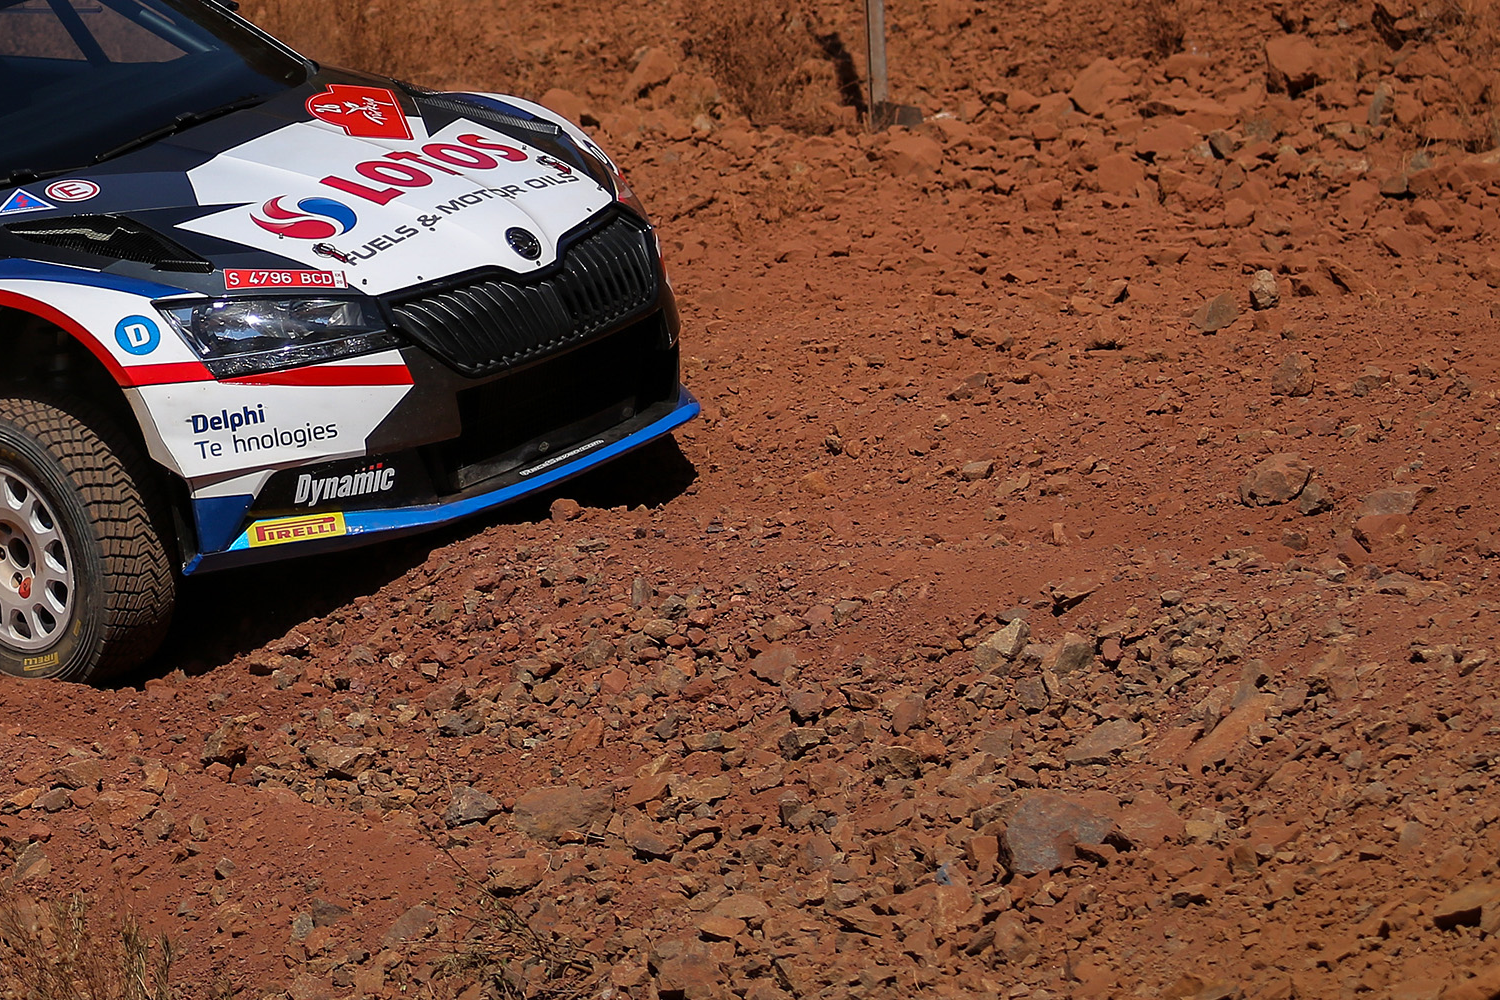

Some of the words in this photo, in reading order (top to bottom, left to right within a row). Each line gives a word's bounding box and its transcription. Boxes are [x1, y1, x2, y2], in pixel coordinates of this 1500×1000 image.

[320, 133, 529, 206] LOTOS
[416, 213, 443, 228] &
[435, 184, 528, 215] MOTOR
[523, 171, 580, 190] OILS
[228, 272, 240, 286] S
[249, 271, 293, 285] 4796
[300, 272, 333, 285] BCD
[123, 323, 151, 348] D
[190, 403, 266, 434] Delphi
[294, 464, 396, 507] Dynamic
[256, 516, 337, 542] PIRELLI
[23, 651, 60, 672] PIRELLI
